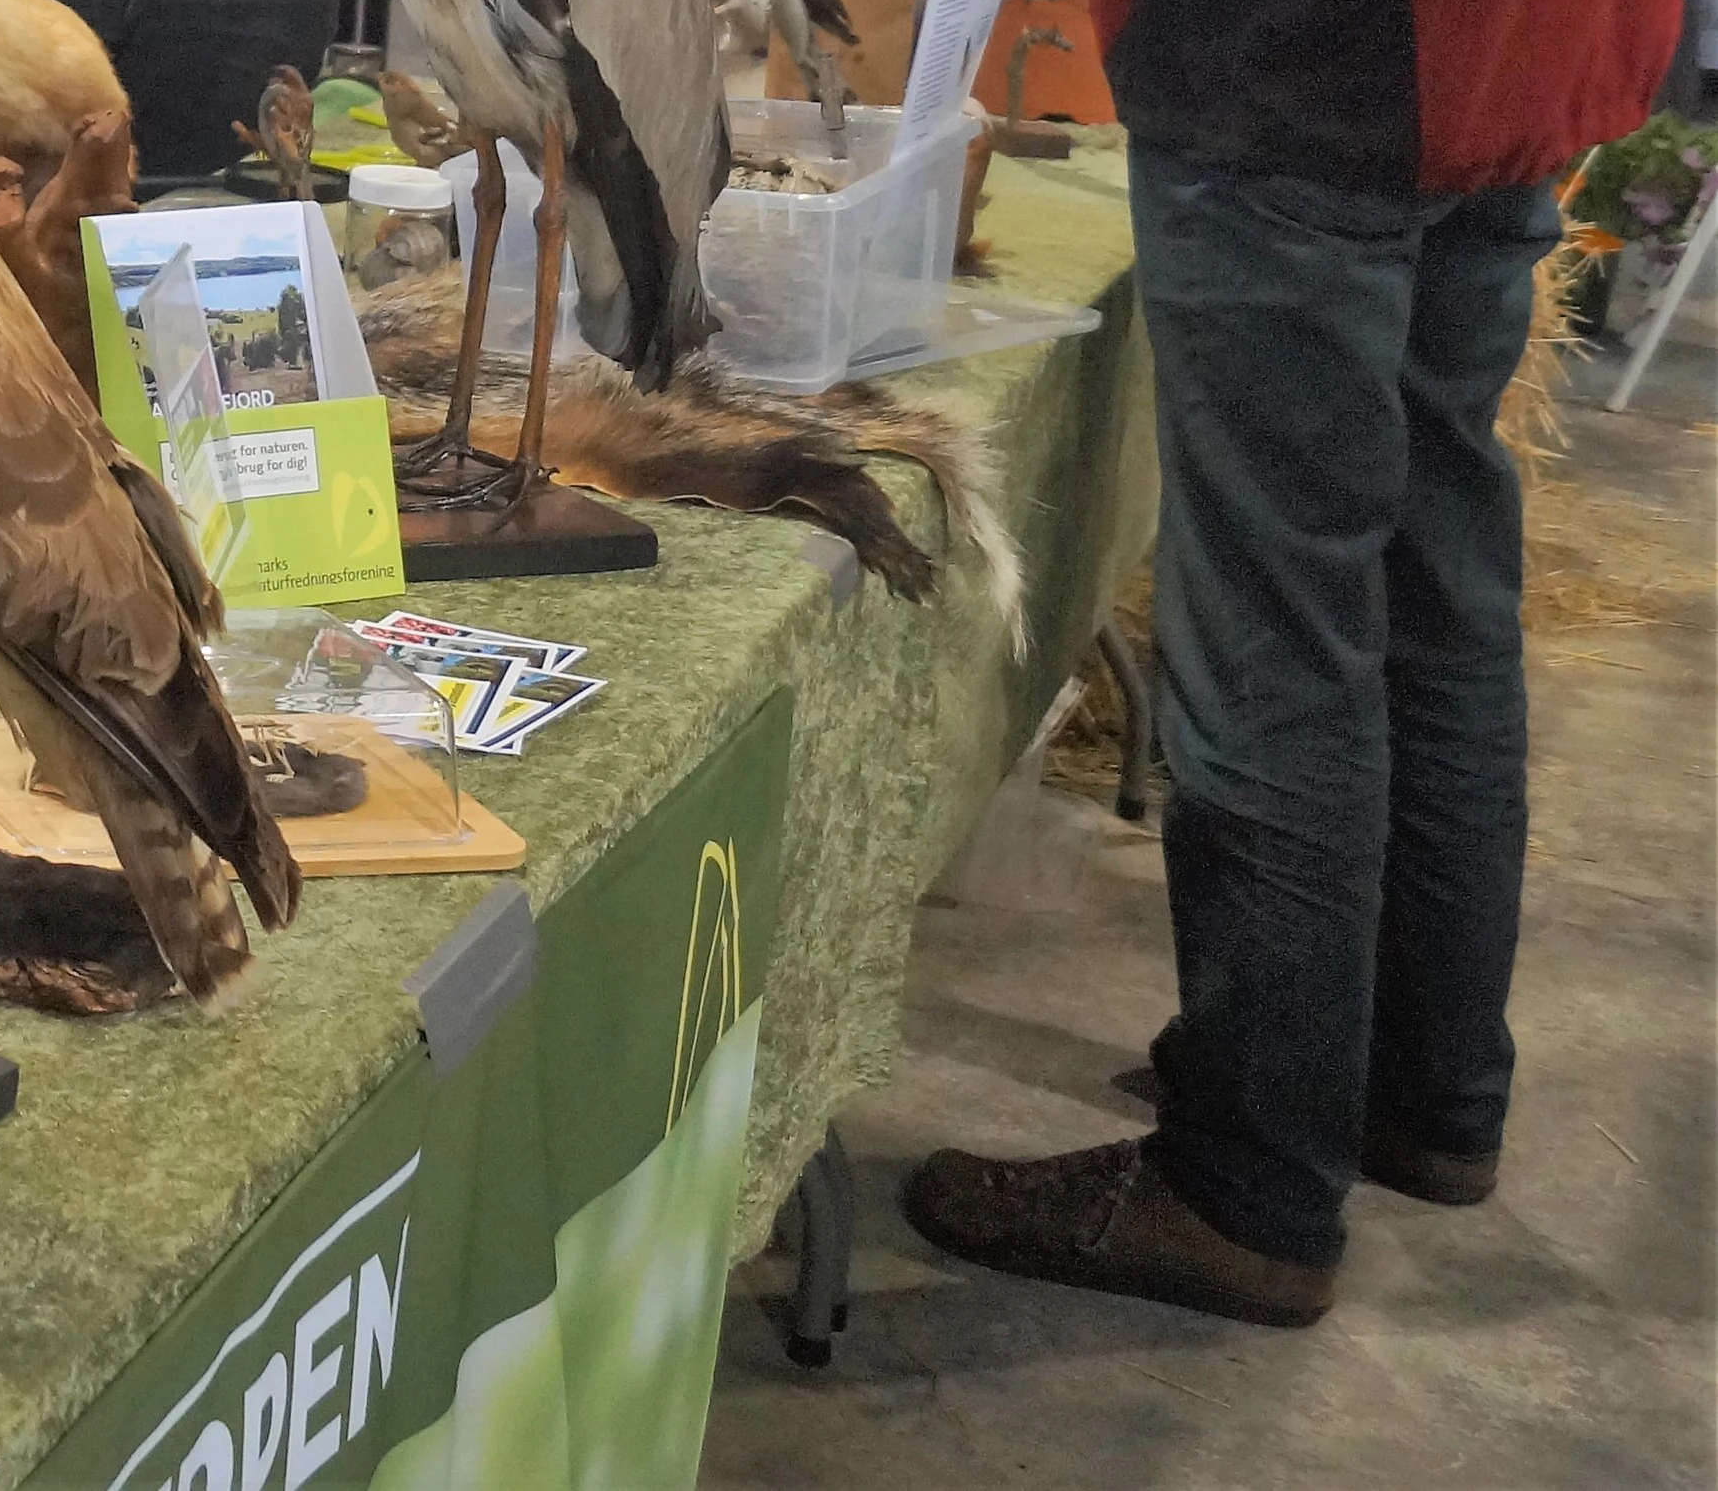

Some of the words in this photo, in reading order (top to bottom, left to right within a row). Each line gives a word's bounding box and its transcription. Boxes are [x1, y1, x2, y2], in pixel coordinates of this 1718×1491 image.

[239, 443, 257, 457] for
[260, 440, 309, 456] naturen.
[236, 462, 264, 476] brug
[266, 460, 283, 472] for
[155, 1214, 410, 1491] PEN
